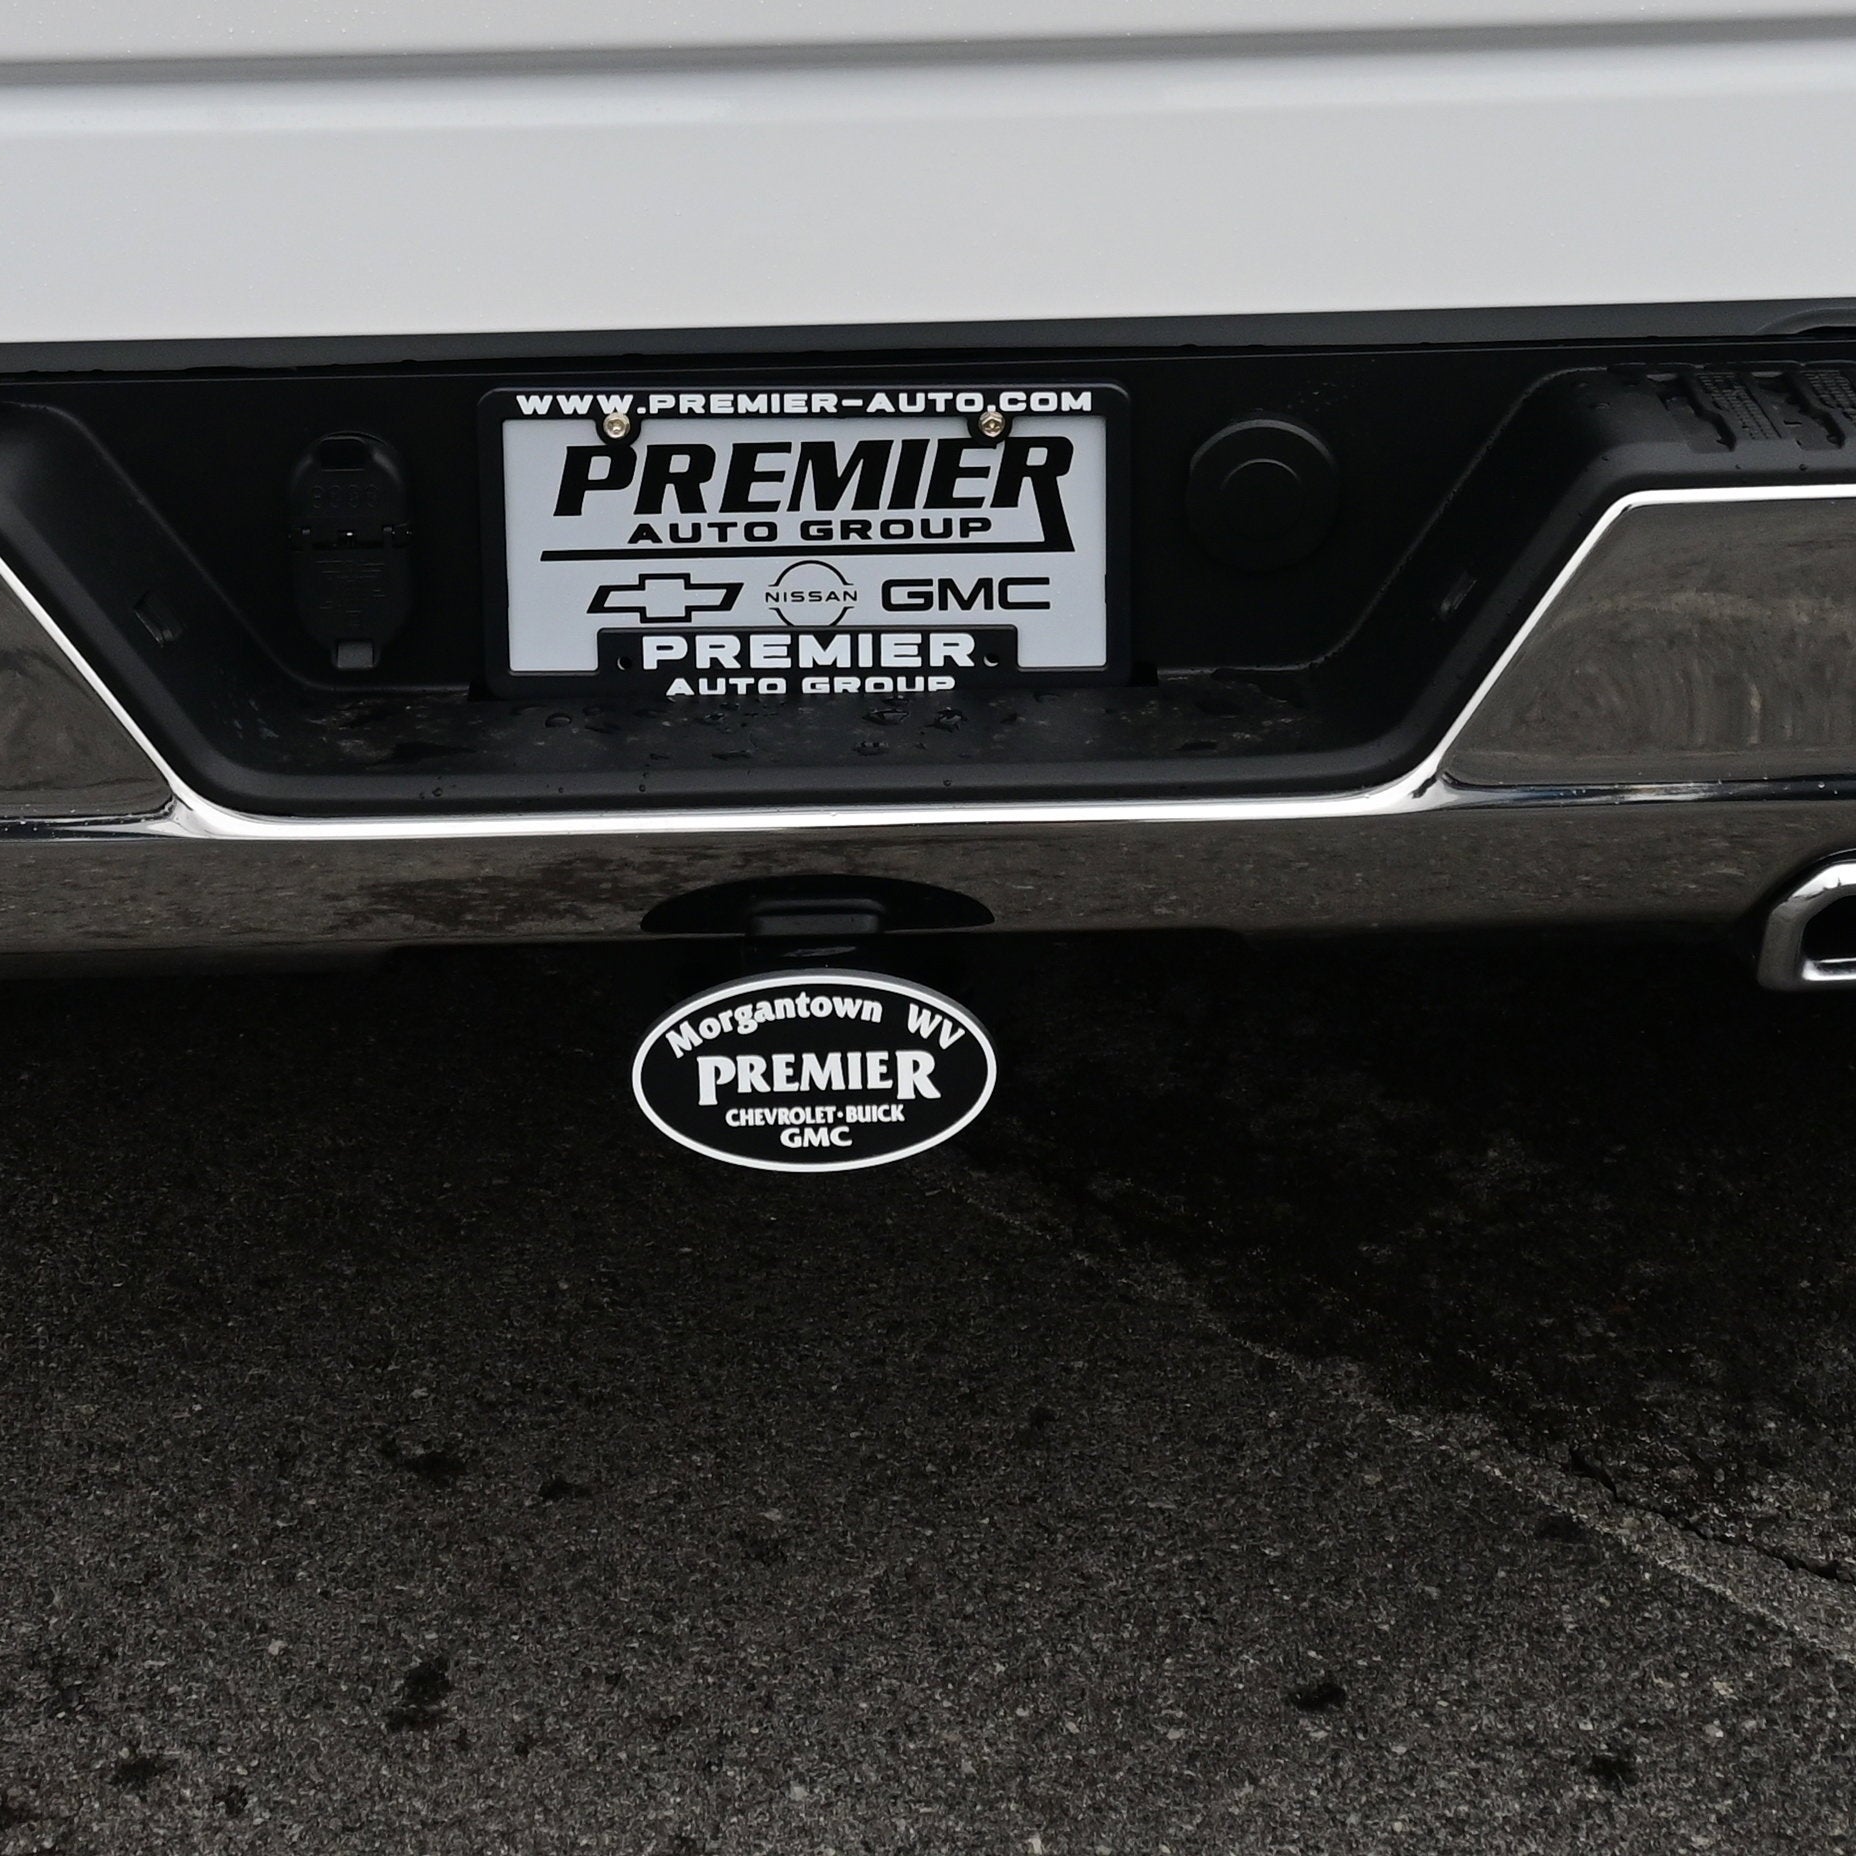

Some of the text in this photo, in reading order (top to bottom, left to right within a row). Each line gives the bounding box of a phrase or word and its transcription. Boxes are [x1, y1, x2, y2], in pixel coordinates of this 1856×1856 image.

[516, 392, 1093, 415] WWW.PREMIER-AUTO.COM
[553, 436, 1075, 536] PREMIER
[627, 518, 992, 544] AUTO GROUP
[765, 577, 1051, 612] NISSAN GMC
[642, 633, 976, 670] PREMIER
[666, 676, 956, 696] AUTO GROUP
[665, 992, 966, 1059] Morgantown WV
[696, 1050, 942, 1106] PREMIER
[725, 1104, 905, 1127] CHEVROLET BUICK
[780, 1126, 853, 1148] GMC
